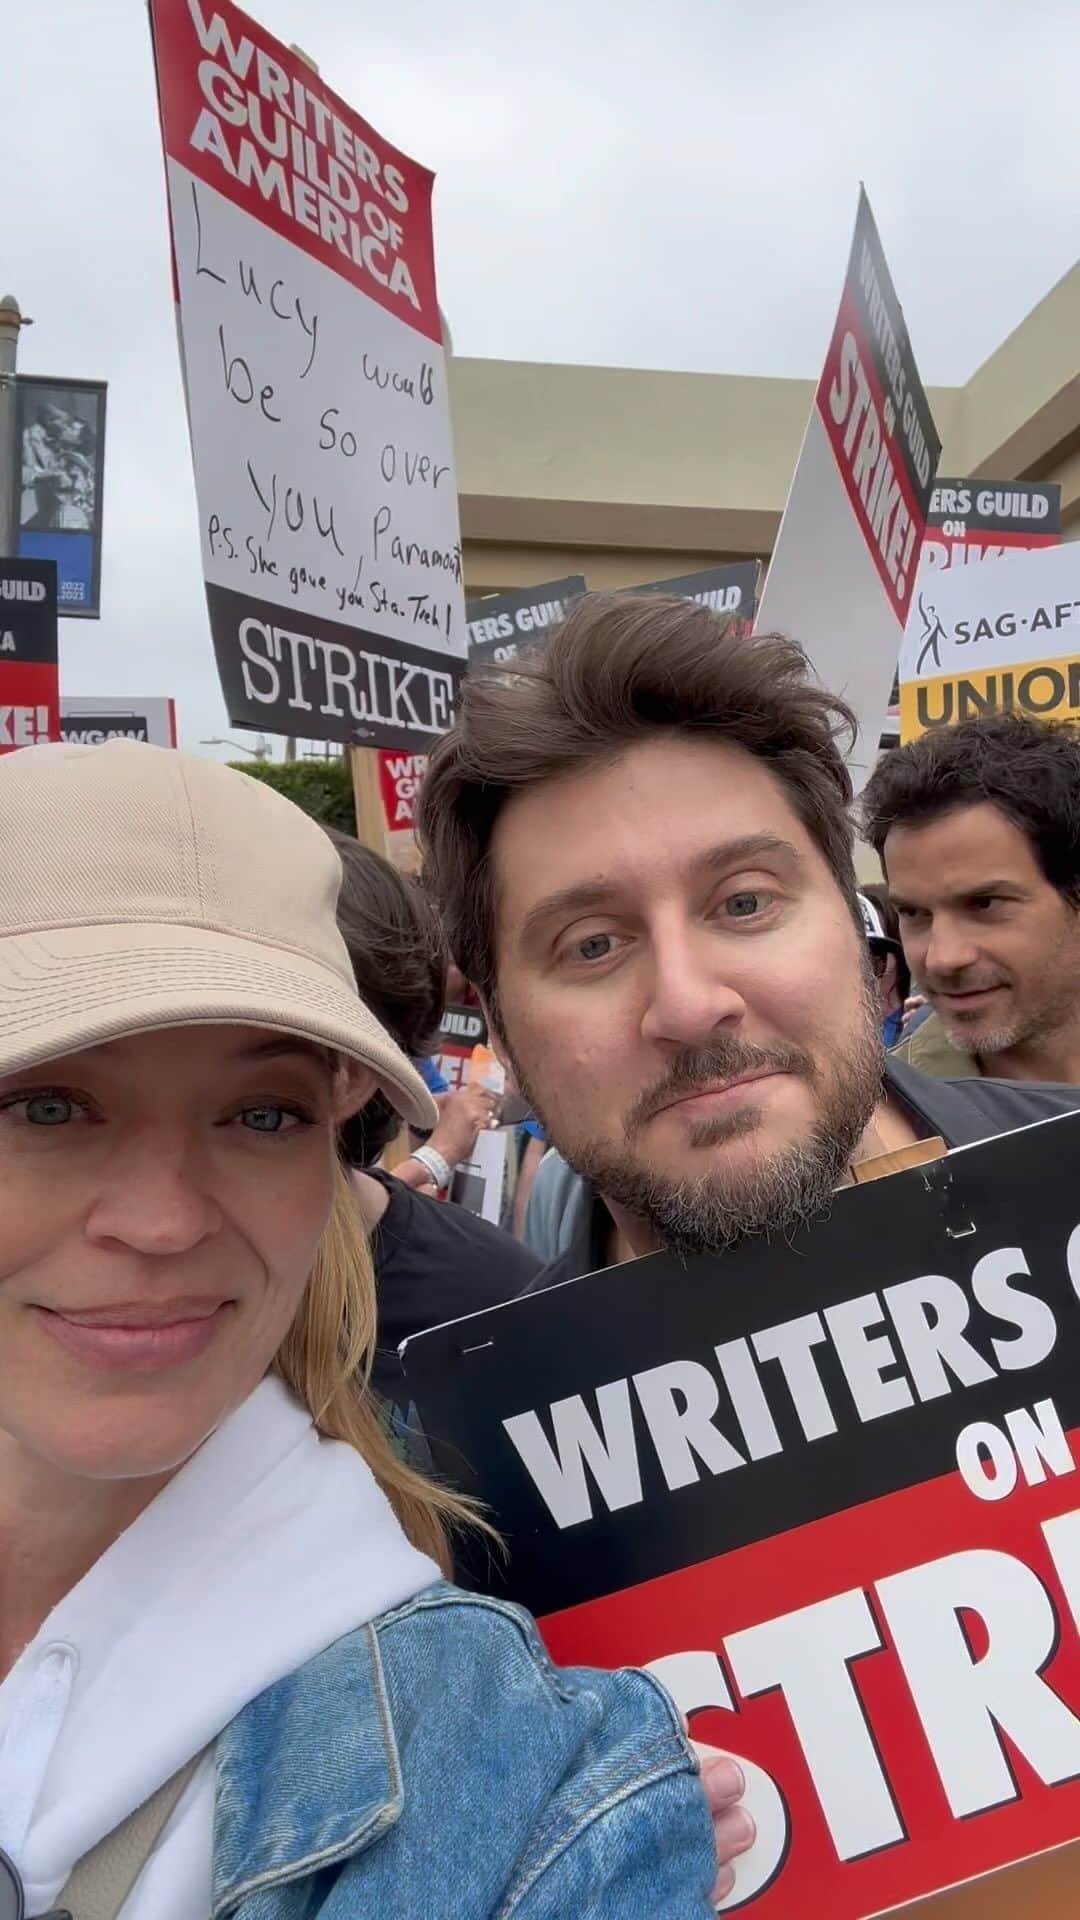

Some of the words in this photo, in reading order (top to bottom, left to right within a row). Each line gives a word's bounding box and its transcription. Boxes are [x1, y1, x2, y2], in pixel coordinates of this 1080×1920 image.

[187, 0, 409, 214] WRITERS
[198, 59, 361, 214] GUILD
[363, 201, 404, 250] OF
[190, 107, 422, 312] AMERICA
[191, 181, 319, 379] Lucy
[218, 323, 282, 423] be
[860, 238, 907, 409] WRITERS
[902, 391, 931, 489] GUILD
[828, 330, 917, 600] STRIKE!
[941, 519, 967, 538] ON
[976, 490, 1049, 519] GUILD
[0, 579, 47, 602] UILD
[245, 535, 279, 576] She
[289, 566, 327, 595] gave
[238, 616, 455, 735] STRIKE
[502, 1246, 1058, 1530] WRITERS
[956, 1397, 1075, 1504] ON
[640, 1508, 1080, 1915] STR
